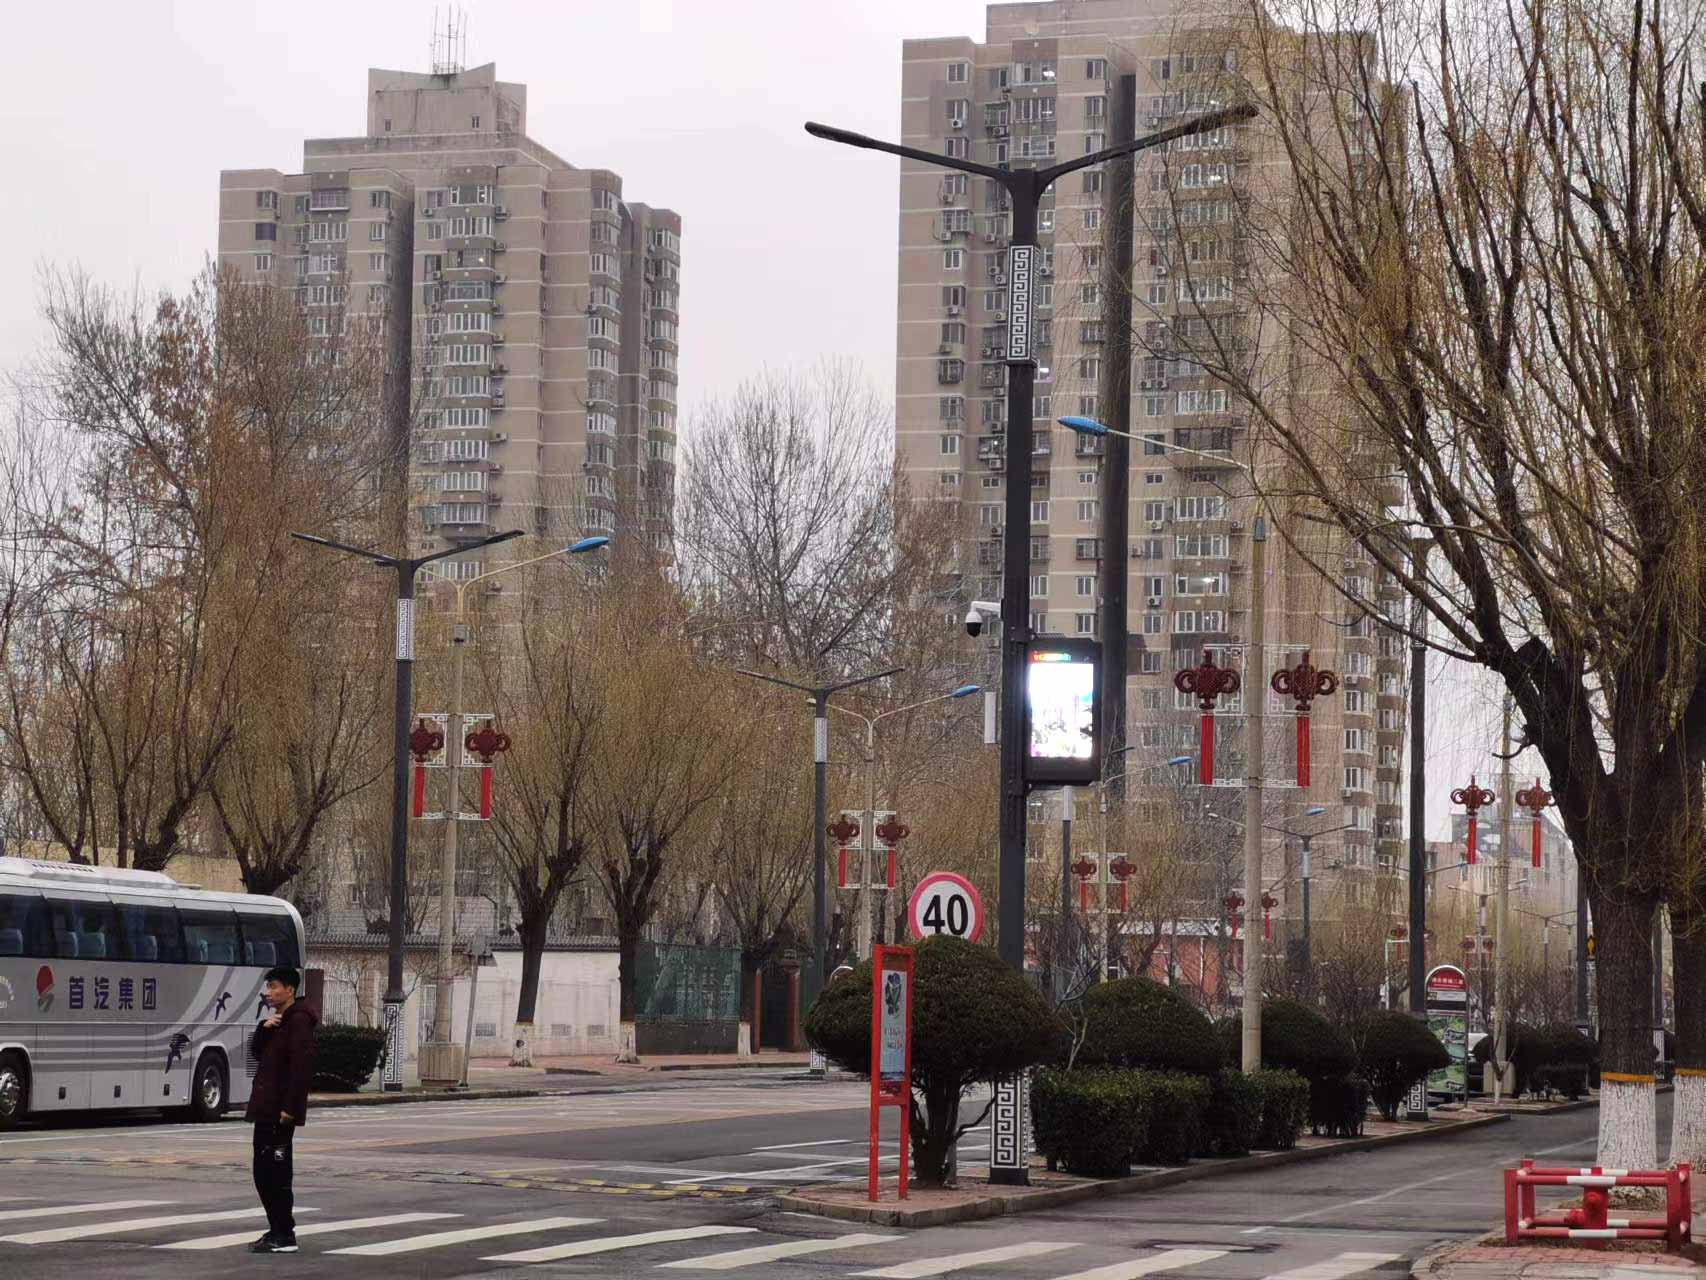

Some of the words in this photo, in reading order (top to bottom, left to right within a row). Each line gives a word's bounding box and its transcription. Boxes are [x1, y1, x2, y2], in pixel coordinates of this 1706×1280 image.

[923, 894, 968, 935] 40
[69, 976, 156, 1010] 首汽集团
